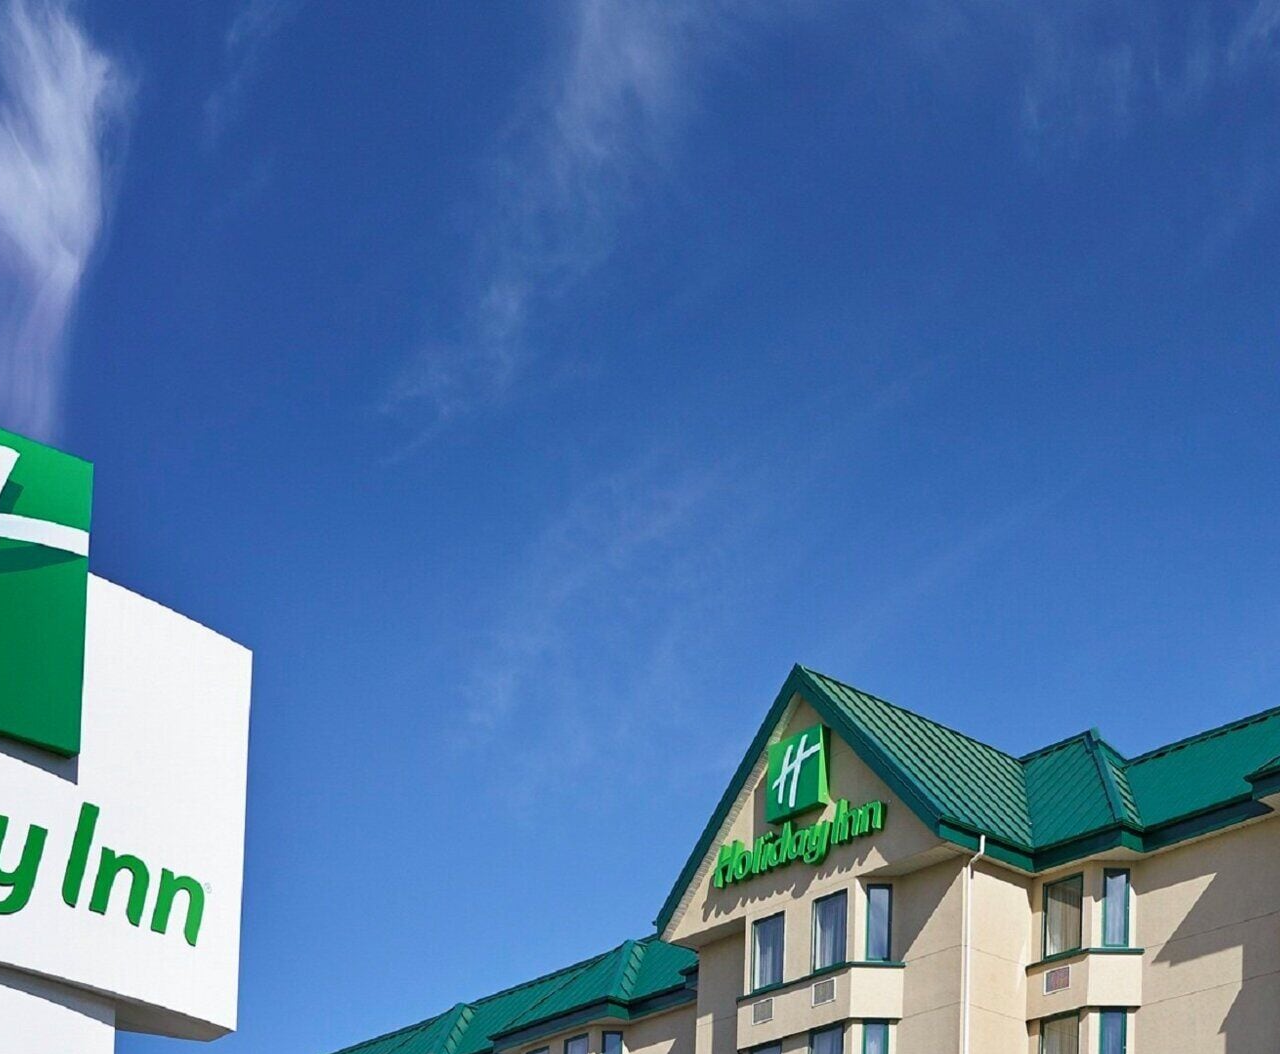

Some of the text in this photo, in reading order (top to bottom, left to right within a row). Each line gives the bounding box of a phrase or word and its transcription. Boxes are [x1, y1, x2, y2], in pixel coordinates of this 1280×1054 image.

[61, 802, 206, 947] Inn
[713, 799, 886, 889] Holiday Inn
